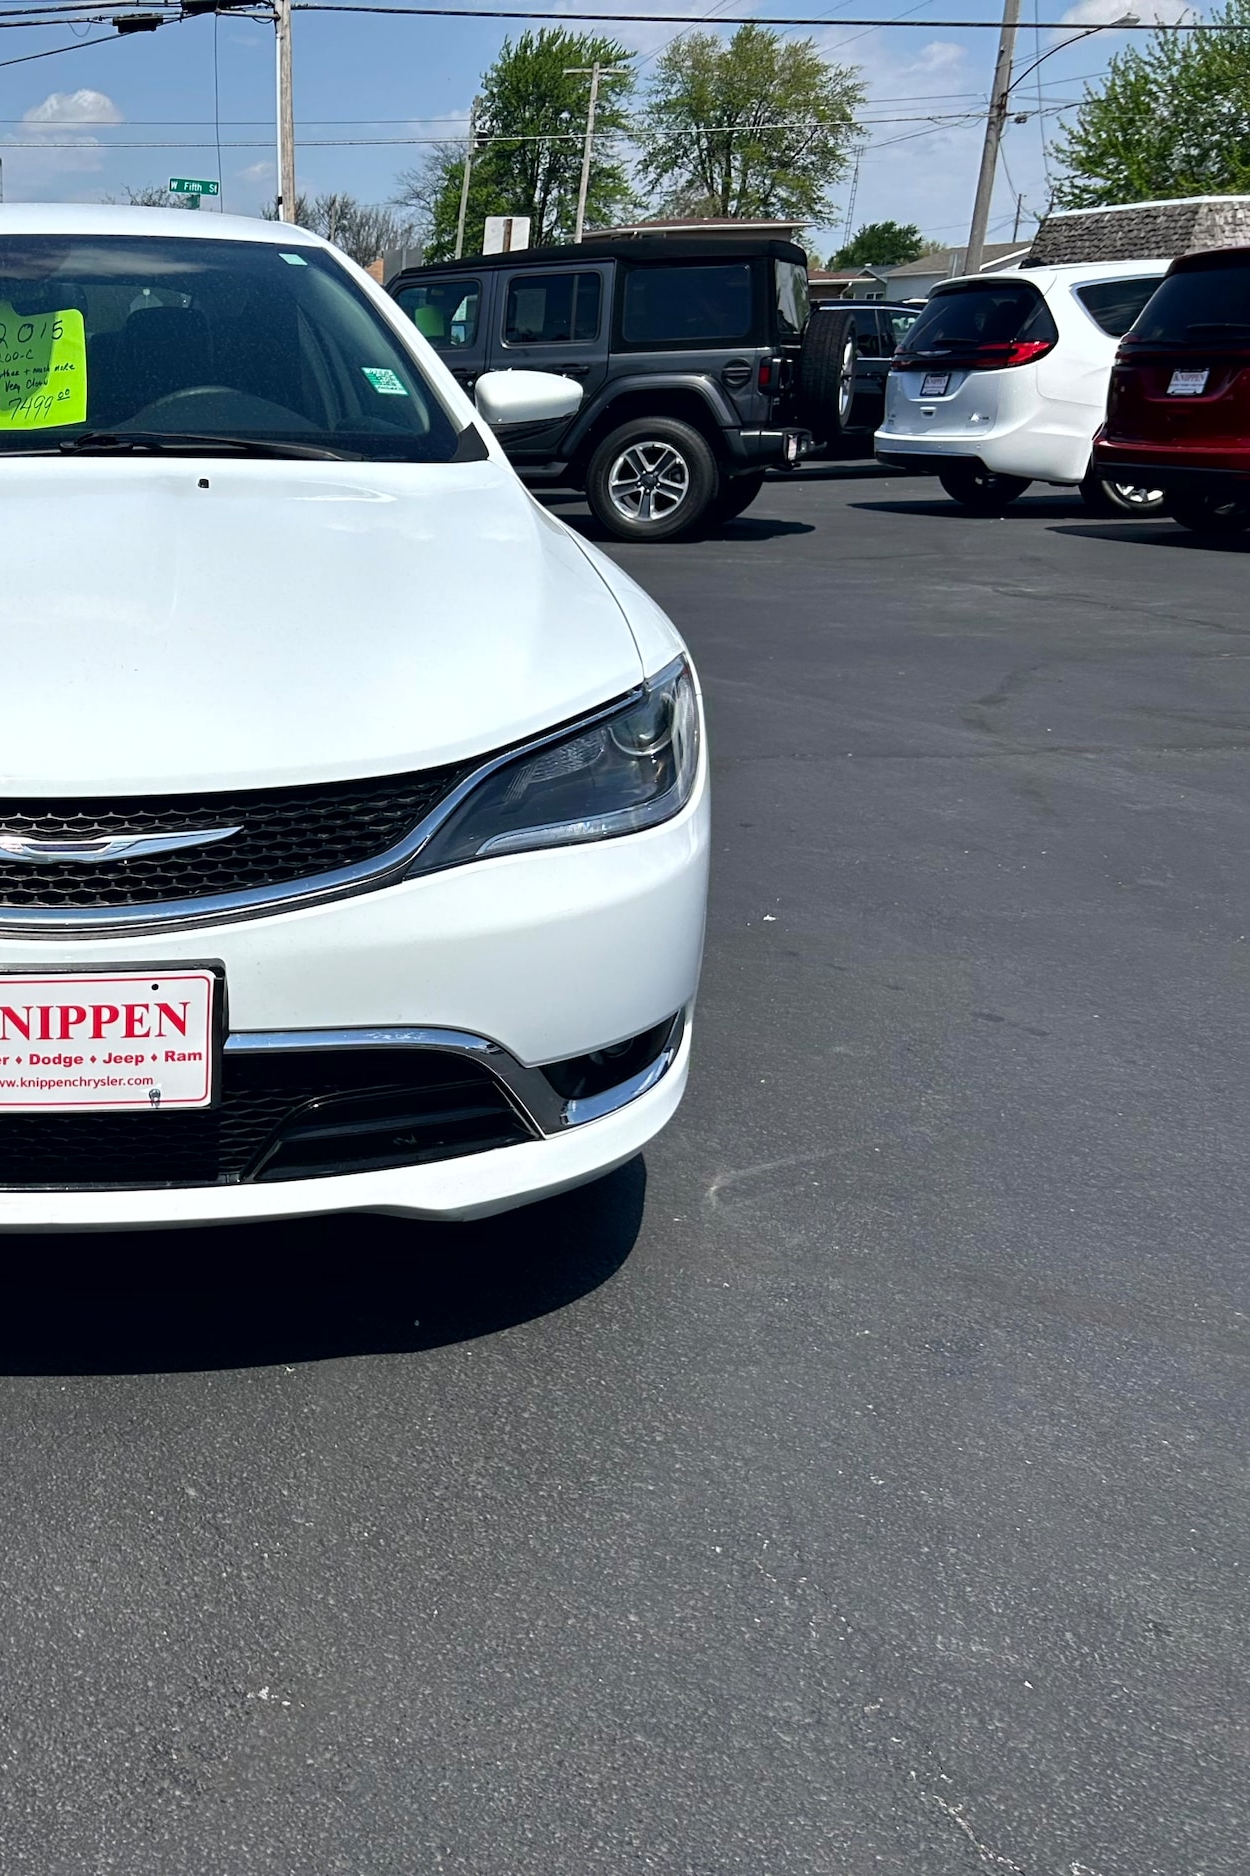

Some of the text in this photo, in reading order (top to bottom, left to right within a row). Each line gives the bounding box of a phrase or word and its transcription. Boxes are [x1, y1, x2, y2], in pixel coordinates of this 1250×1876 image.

[170, 180, 217, 193] W Fifth St
[8, 396, 54, 420] 7499
[29, 1052, 84, 1068] Dodge
[103, 1051, 145, 1067] Jeep
[164, 1050, 203, 1063] Ram
